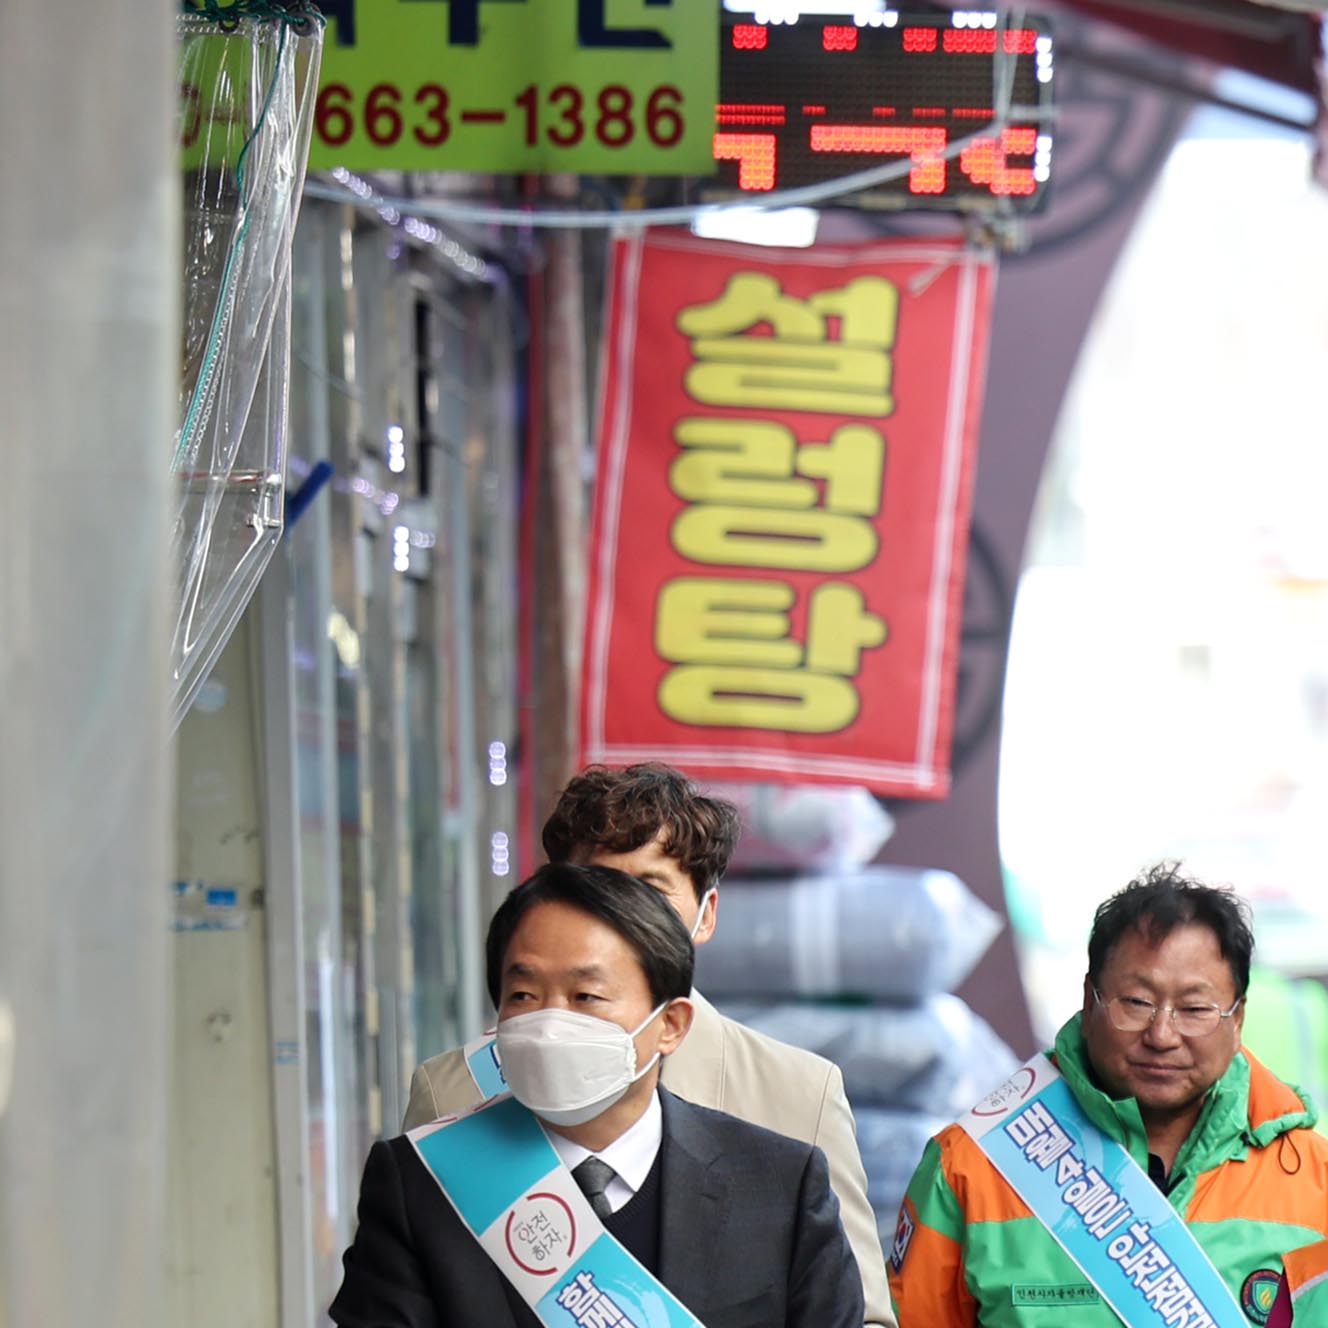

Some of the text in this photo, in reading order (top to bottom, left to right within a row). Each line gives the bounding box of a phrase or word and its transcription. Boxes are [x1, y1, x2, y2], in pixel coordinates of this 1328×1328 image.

[654, 272, 900, 735] 설렁탕
[518, 1211, 551, 1245] 안전
[532, 1227, 563, 1261] 하자
